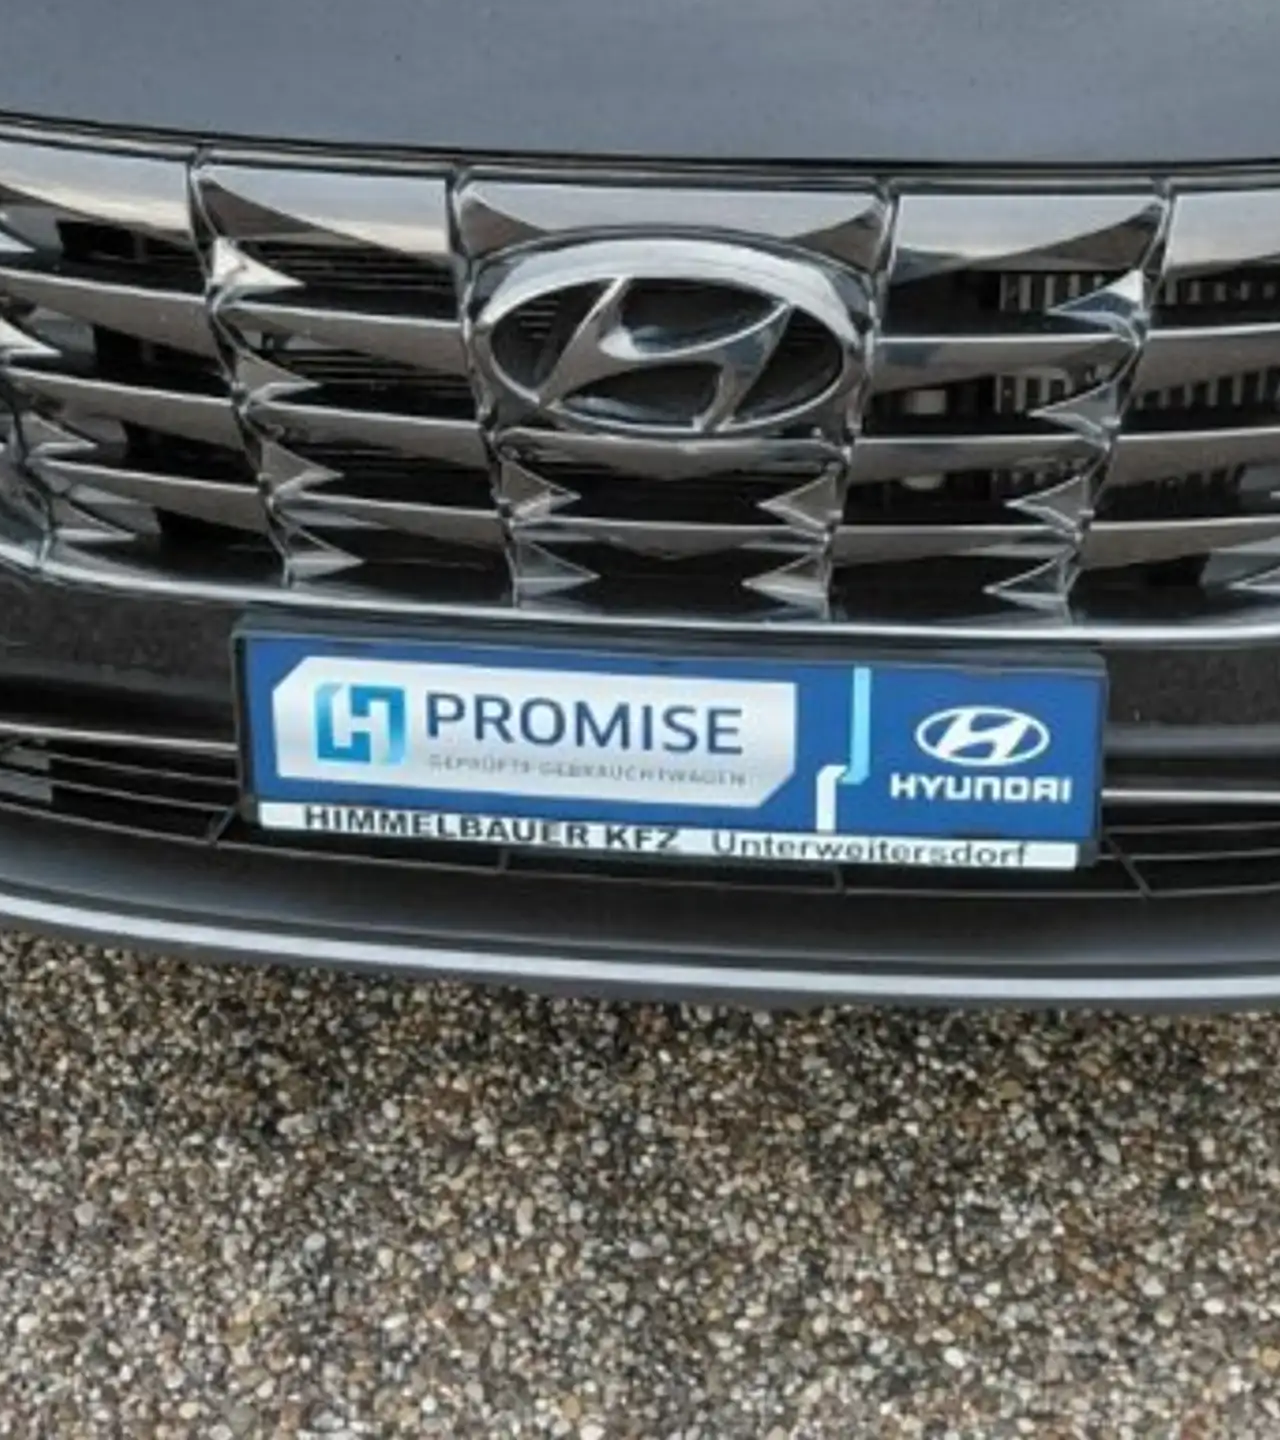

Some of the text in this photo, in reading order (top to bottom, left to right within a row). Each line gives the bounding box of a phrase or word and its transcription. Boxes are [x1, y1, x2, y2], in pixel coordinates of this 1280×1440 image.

[424, 690, 744, 756] PROMISE
[889, 772, 1073, 804] HYUNDAI
[304, 805, 1027, 868] HIMMELBAUER KFZ Unterweitersdorf
